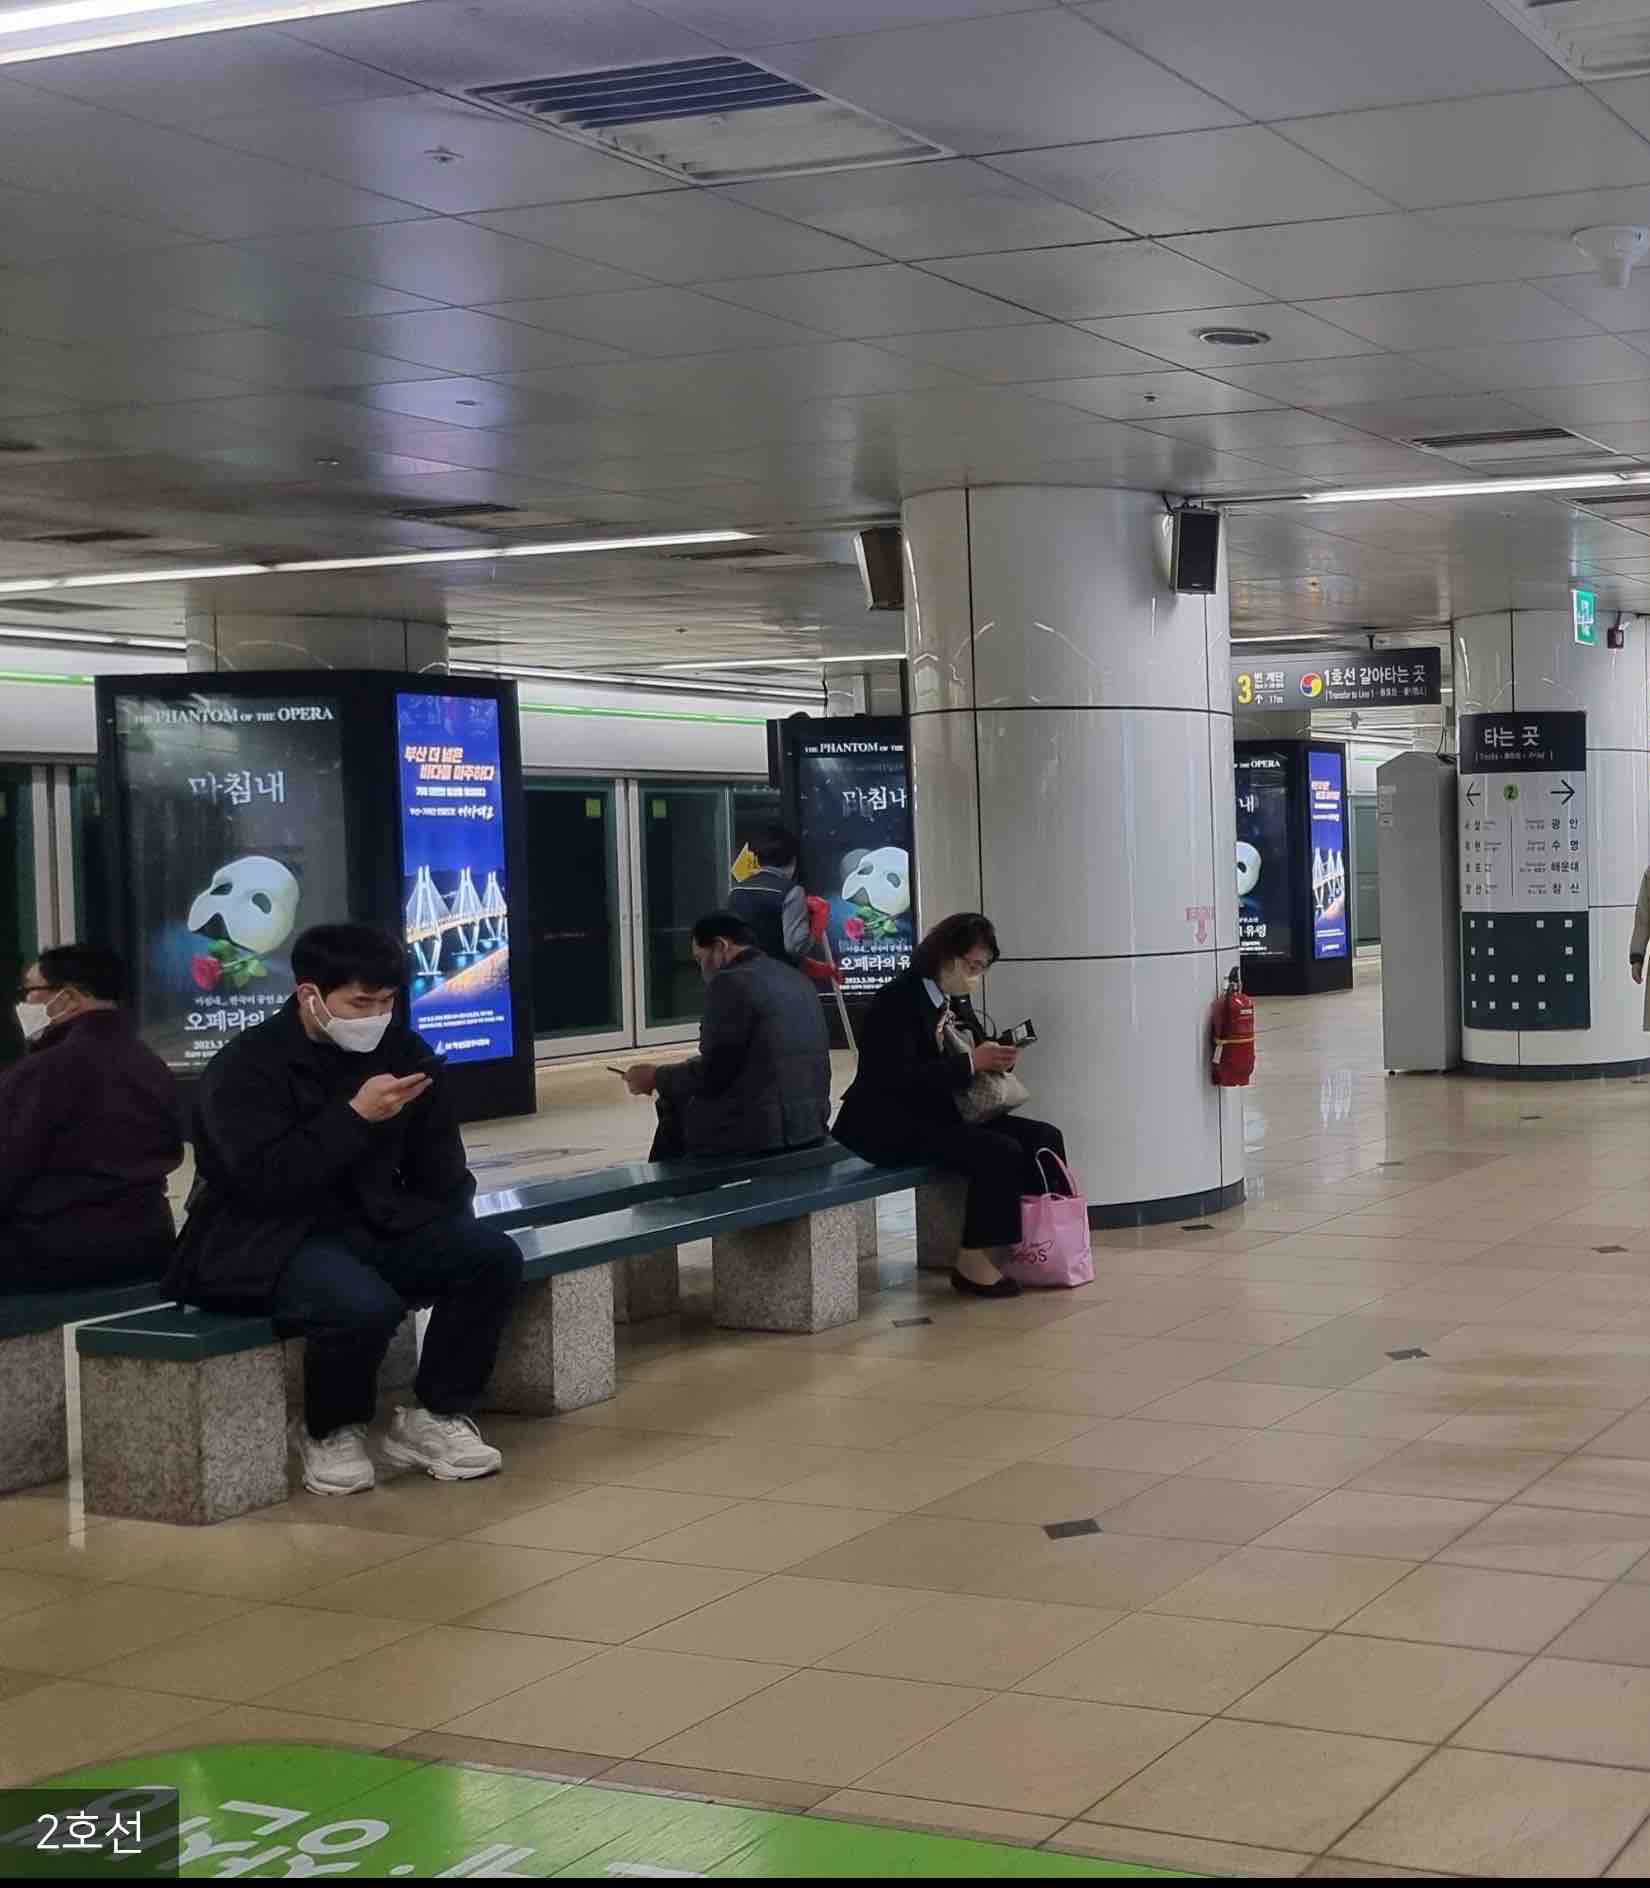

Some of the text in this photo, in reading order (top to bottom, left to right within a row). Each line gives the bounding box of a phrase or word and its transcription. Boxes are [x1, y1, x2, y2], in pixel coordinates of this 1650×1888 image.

[1324, 664, 1426, 687] 1호선 갈아타는 곳
[1236, 673, 1253, 704] 3
[156, 708, 239, 723] PHANTOM
[277, 706, 334, 721] OPERA
[820, 742, 879, 753] PHANTOM
[1484, 725, 1540, 748] 타는 곳
[188, 770, 286, 805] 마침내
[897, 955, 911, 969] 유
[184, 1009, 265, 1032] 오페라의
